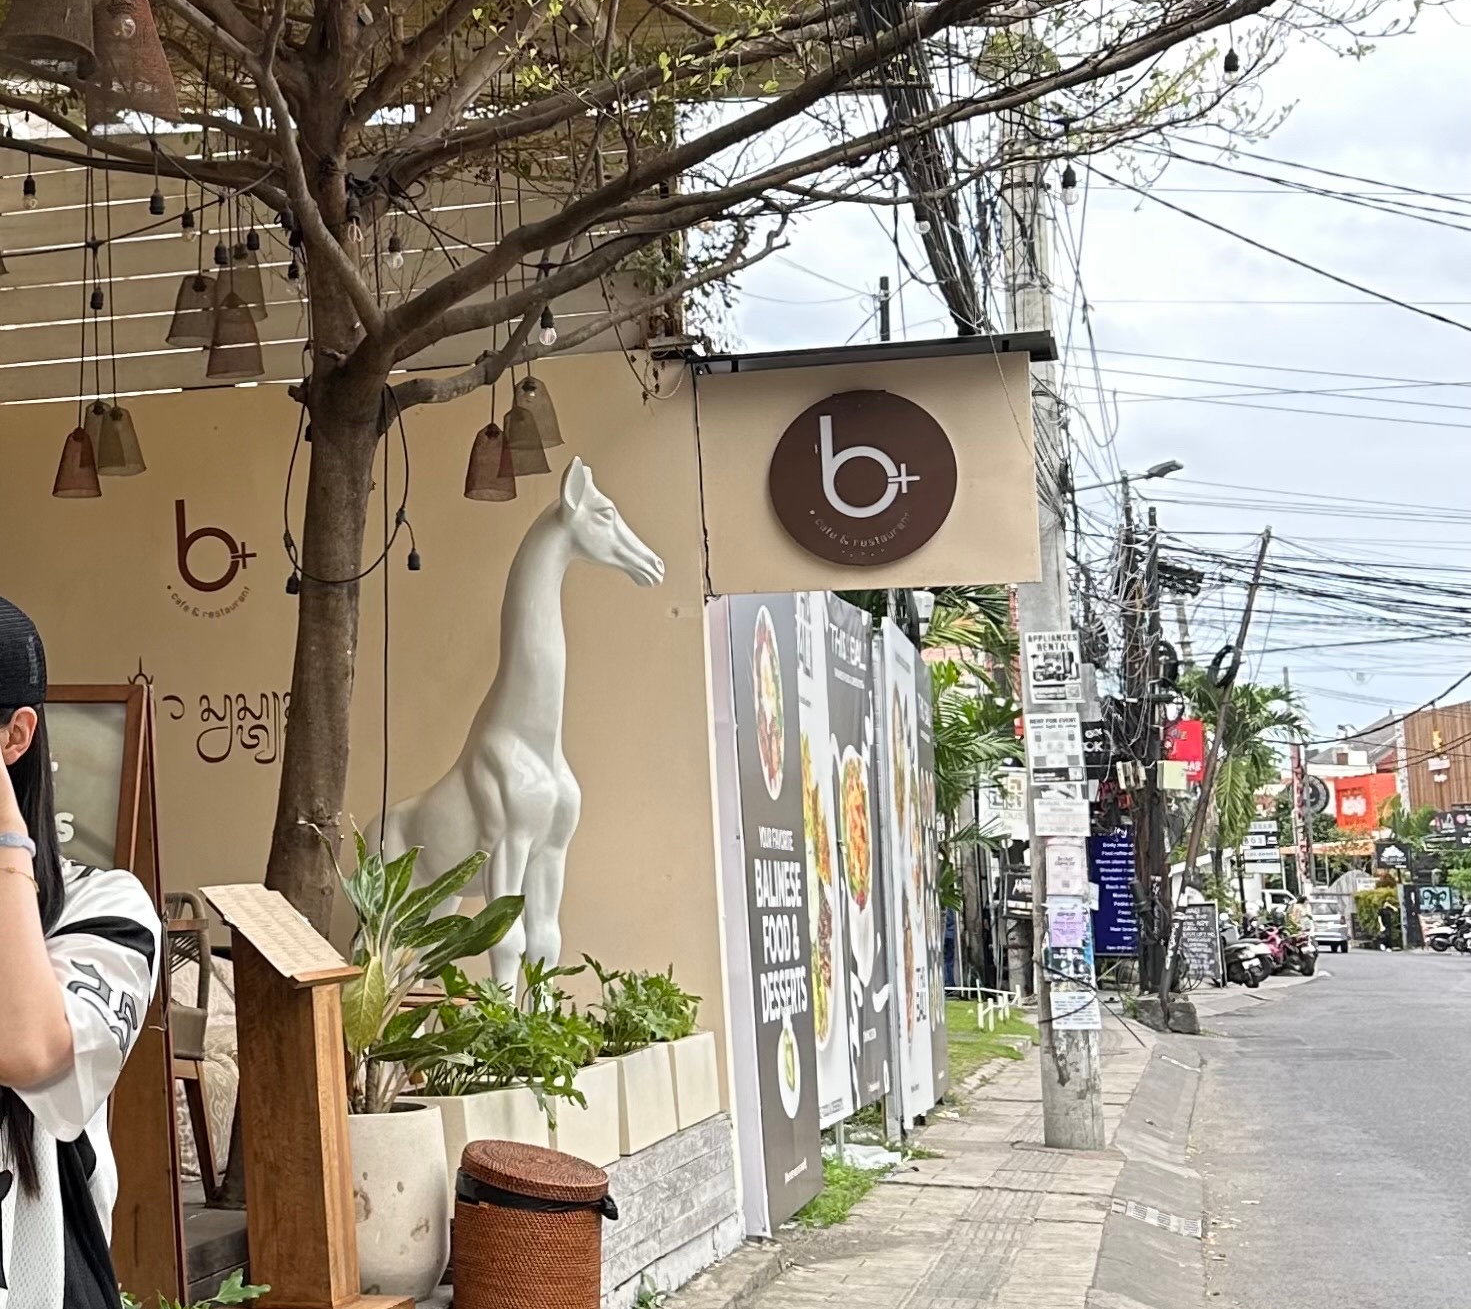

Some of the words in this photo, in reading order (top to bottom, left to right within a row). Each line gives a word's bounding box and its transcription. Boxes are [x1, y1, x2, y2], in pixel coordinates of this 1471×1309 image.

[202, 586, 251, 619] restaurant
[1027, 633, 1078, 643] APPLIANCES
[1036, 642, 1071, 652] RENTAL
[754, 858, 803, 908] BALINESE
[762, 914, 791, 965] FOOD
[792, 913, 801, 961] &
[760, 965, 808, 1024] DESSERTS
